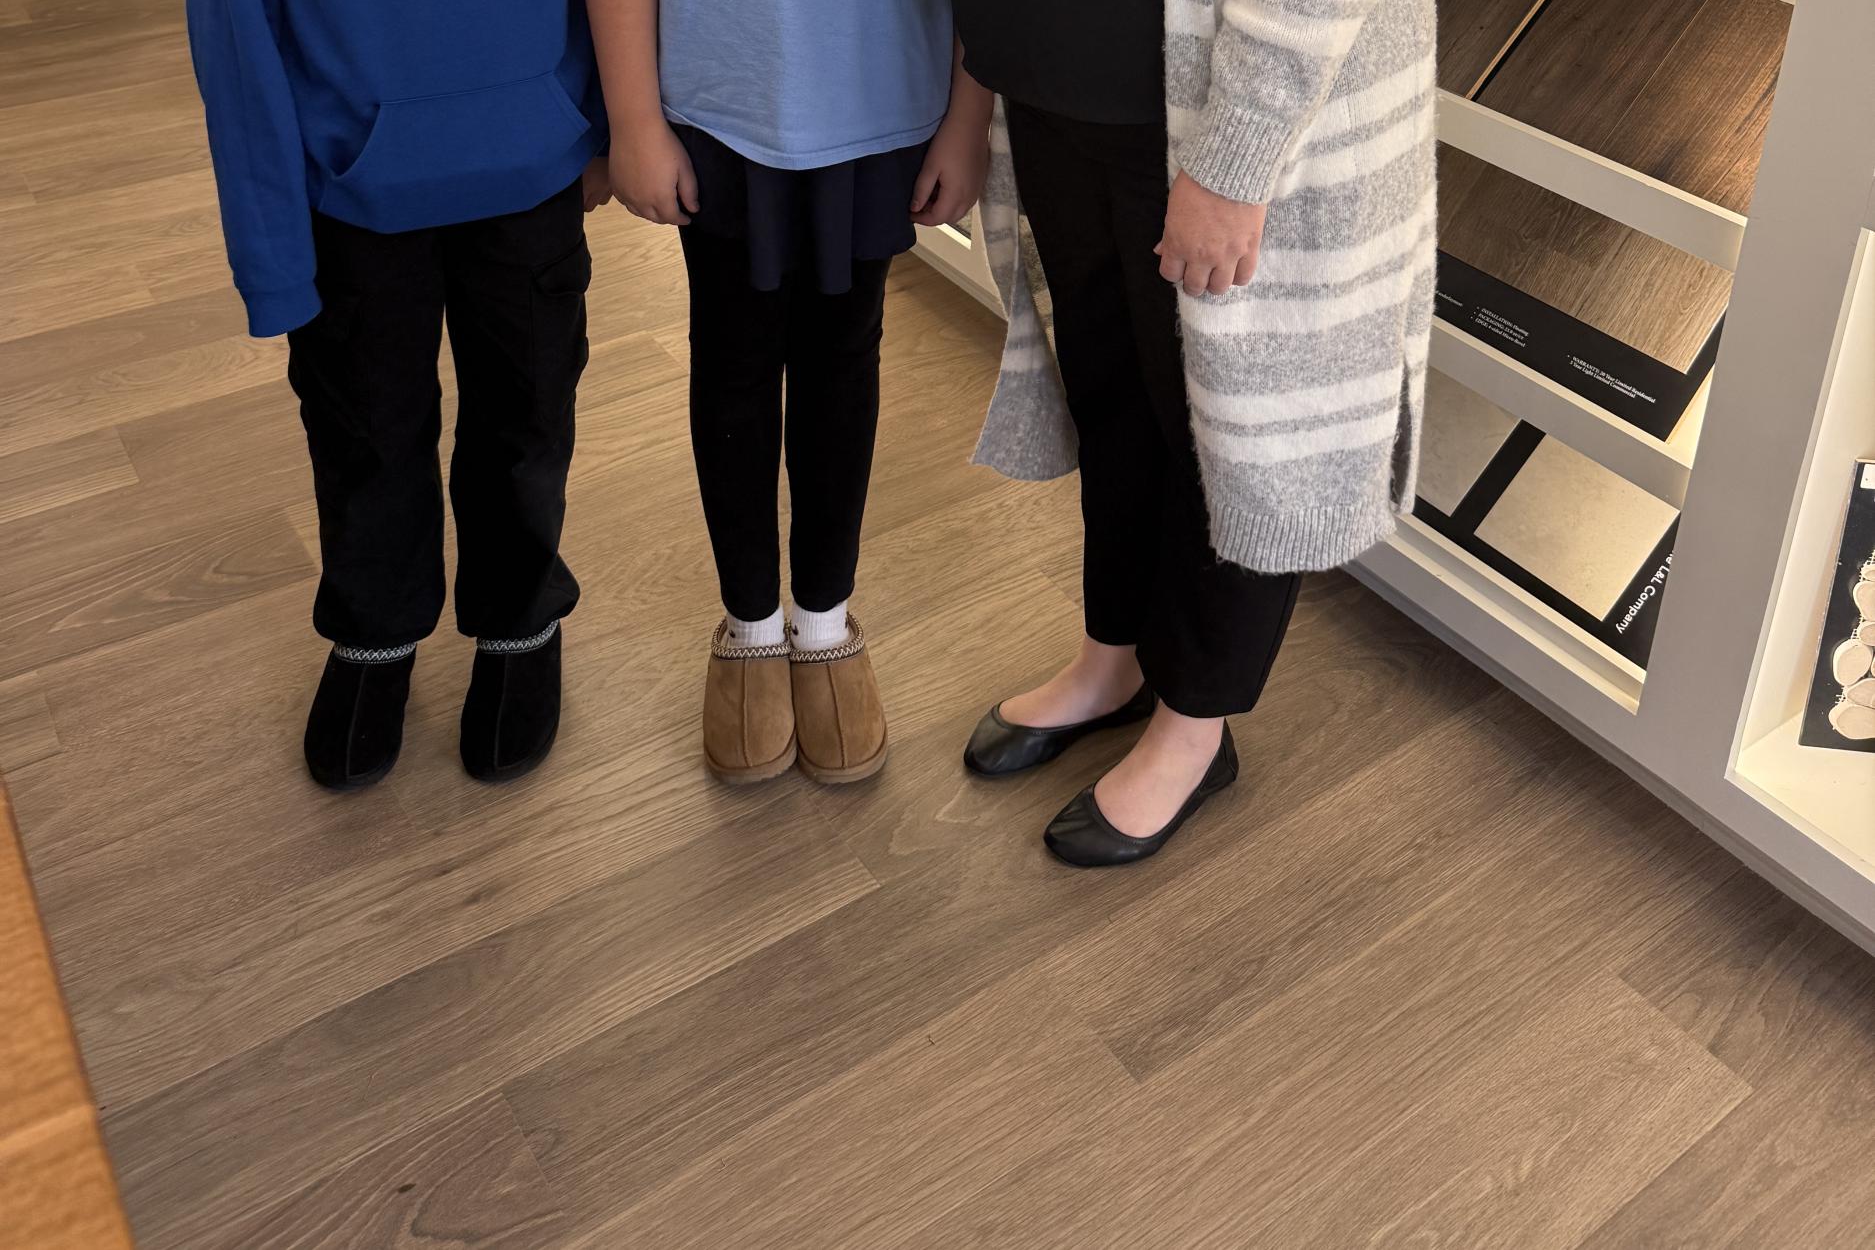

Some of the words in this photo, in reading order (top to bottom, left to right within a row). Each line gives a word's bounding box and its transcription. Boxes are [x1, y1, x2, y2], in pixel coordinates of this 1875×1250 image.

[1573, 362, 1583, 370] Year
[1582, 367, 1594, 376] Light
[1593, 373, 1611, 385] Limited
[1610, 382, 1636, 399] Commercial
[1605, 373, 1616, 383] Year
[1614, 378, 1633, 391] Limited
[1631, 387, 1656, 404] Residential
[1651, 565, 1670, 584] L&L
[1615, 585, 1656, 634] Company
